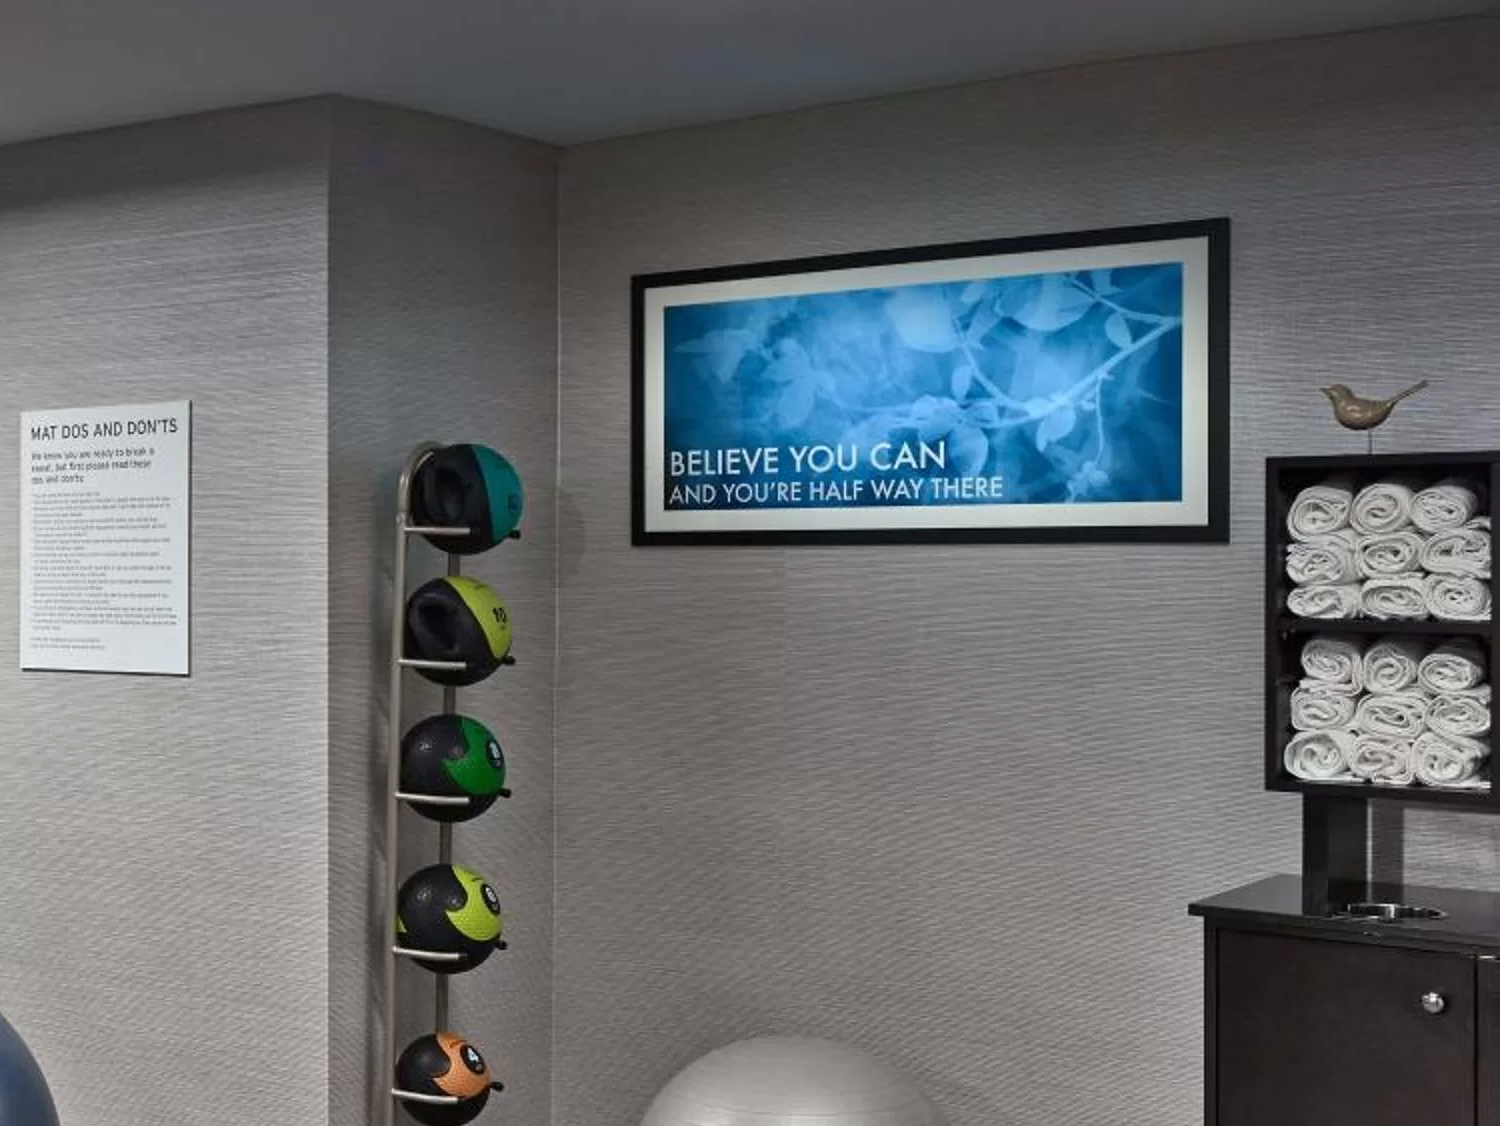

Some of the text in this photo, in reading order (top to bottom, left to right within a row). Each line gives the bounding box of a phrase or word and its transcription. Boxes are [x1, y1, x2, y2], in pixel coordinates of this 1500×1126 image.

[31, 417, 179, 440] MAT DOS AND DON'TS
[64, 451, 77, 461] you
[670, 440, 946, 477] BELIEVE YOU CAN
[69, 461, 85, 471] first
[669, 476, 1004, 505] AND YOU'RE HALF WAY THERE
[492, 607, 507, 624] 10
[467, 1047, 479, 1063] 4
